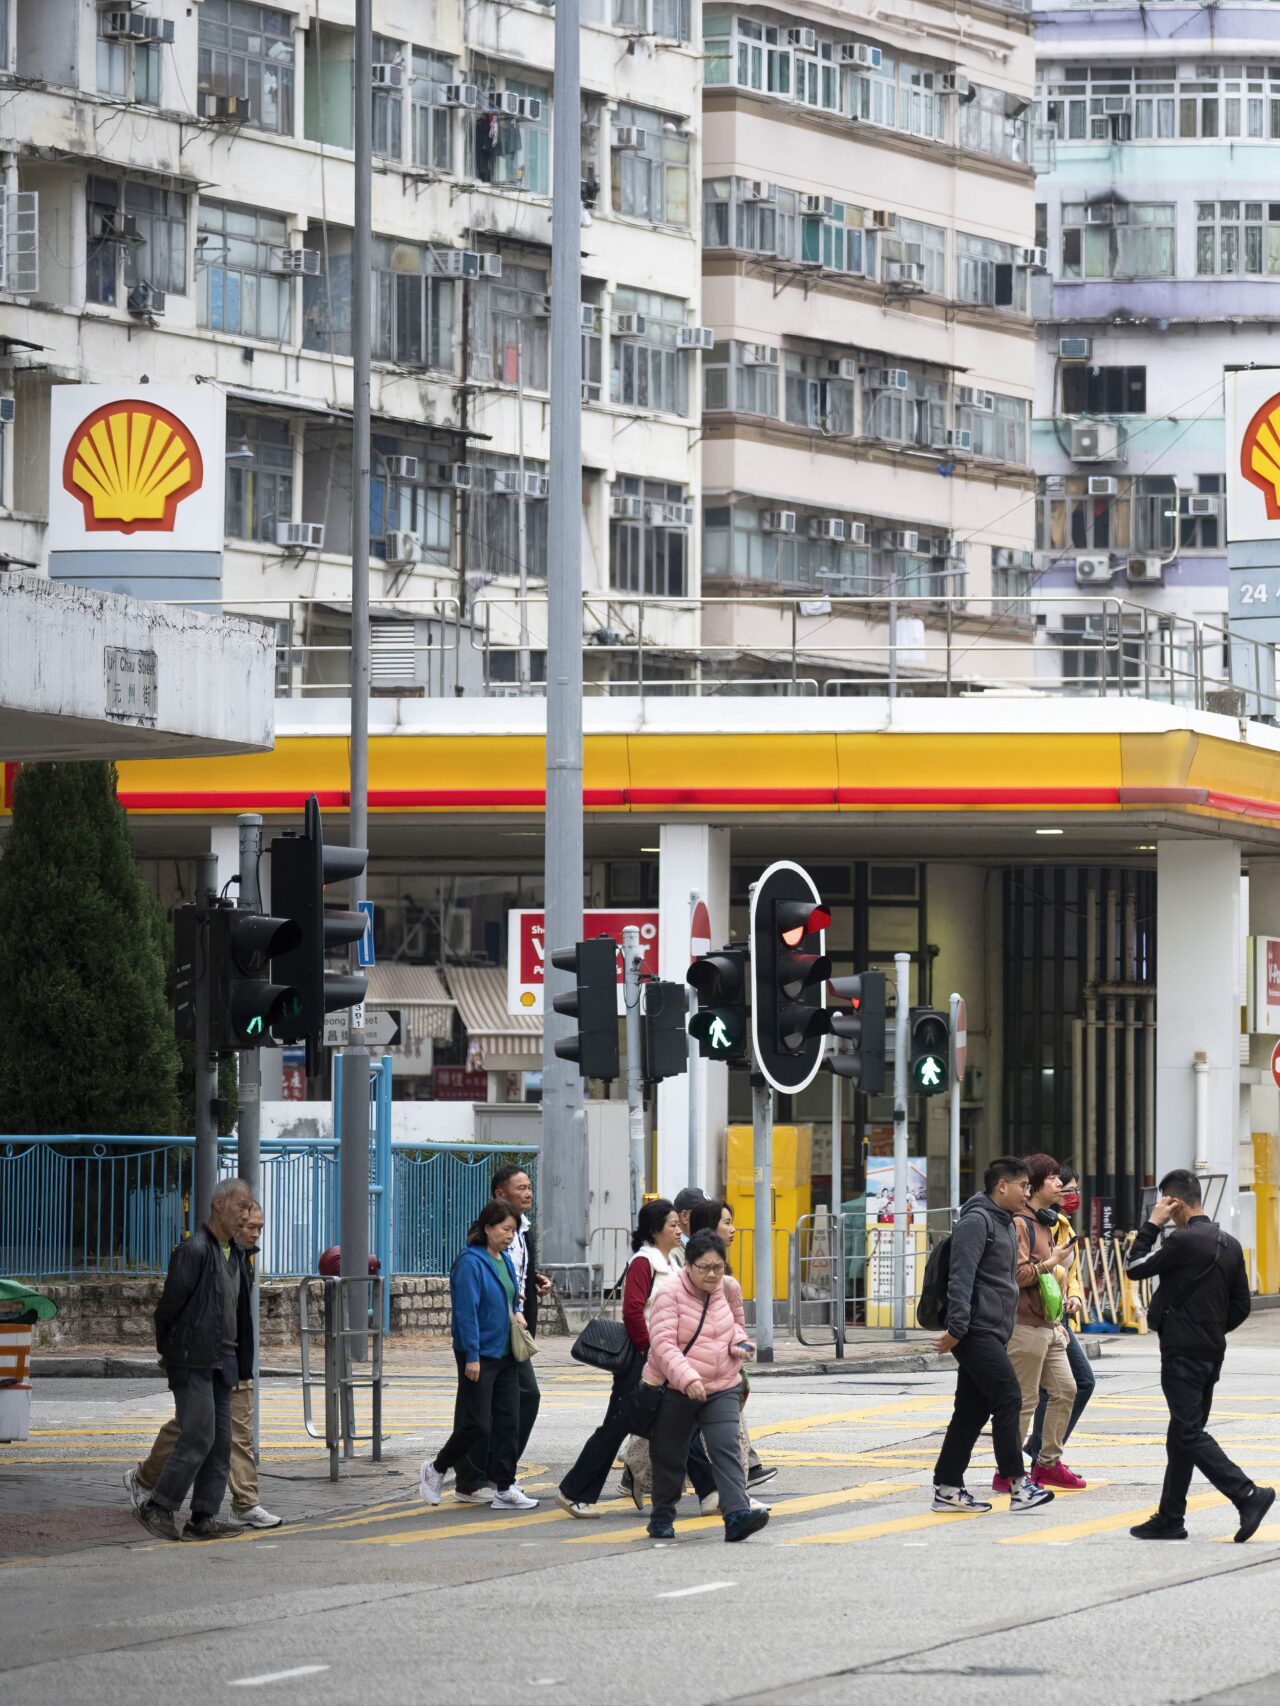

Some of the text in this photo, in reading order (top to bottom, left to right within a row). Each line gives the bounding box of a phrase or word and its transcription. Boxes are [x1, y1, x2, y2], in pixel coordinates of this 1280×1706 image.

[1240, 583, 1268, 604] 24
[107, 655, 155, 676] Un Chau Street
[531, 925, 545, 934] She
[1103, 1205, 1112, 1229] Shell
